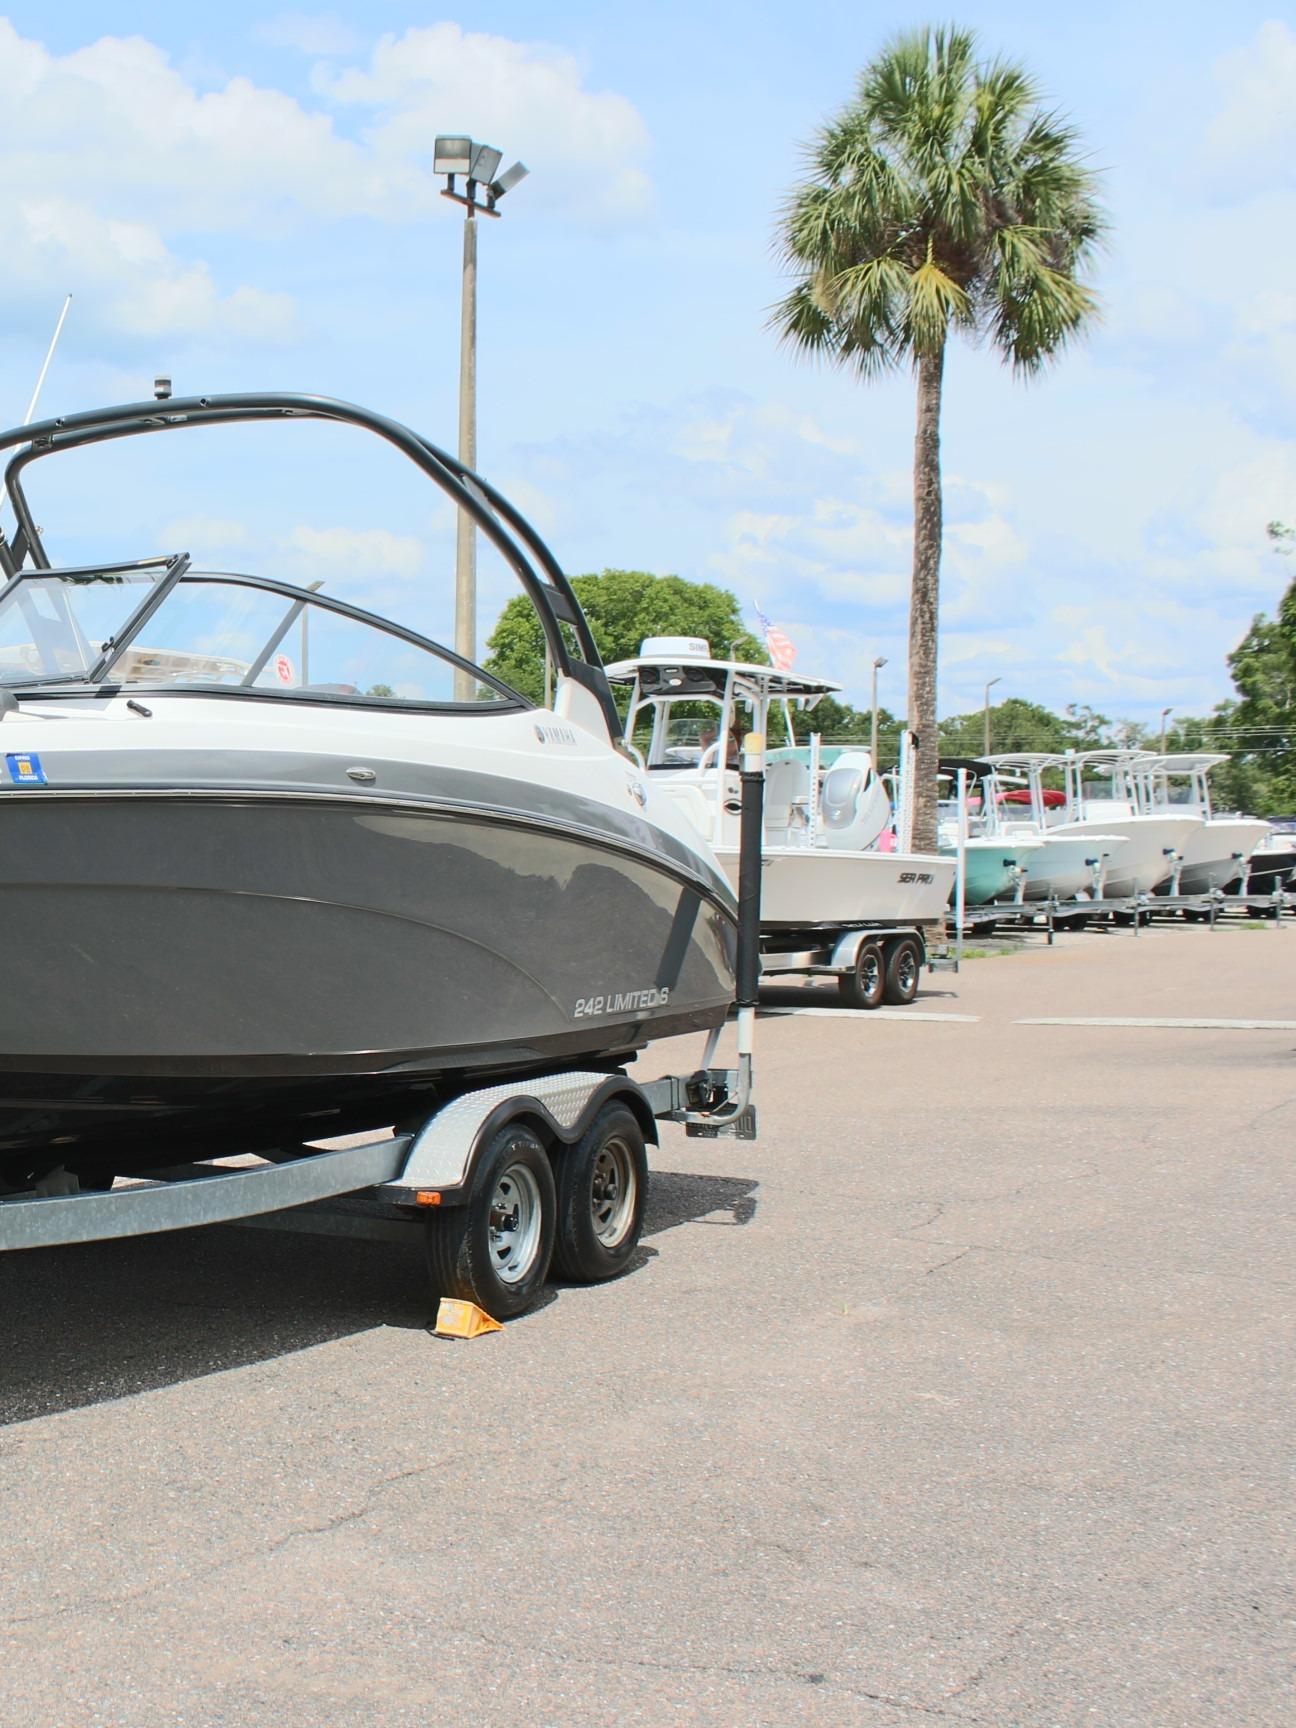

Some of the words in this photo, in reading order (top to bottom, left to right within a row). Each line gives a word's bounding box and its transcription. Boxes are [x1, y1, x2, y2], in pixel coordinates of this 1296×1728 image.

[574, 996, 604, 1018] 242
[606, 988, 658, 1013] LIMITED
[660, 987, 670, 1005] S
